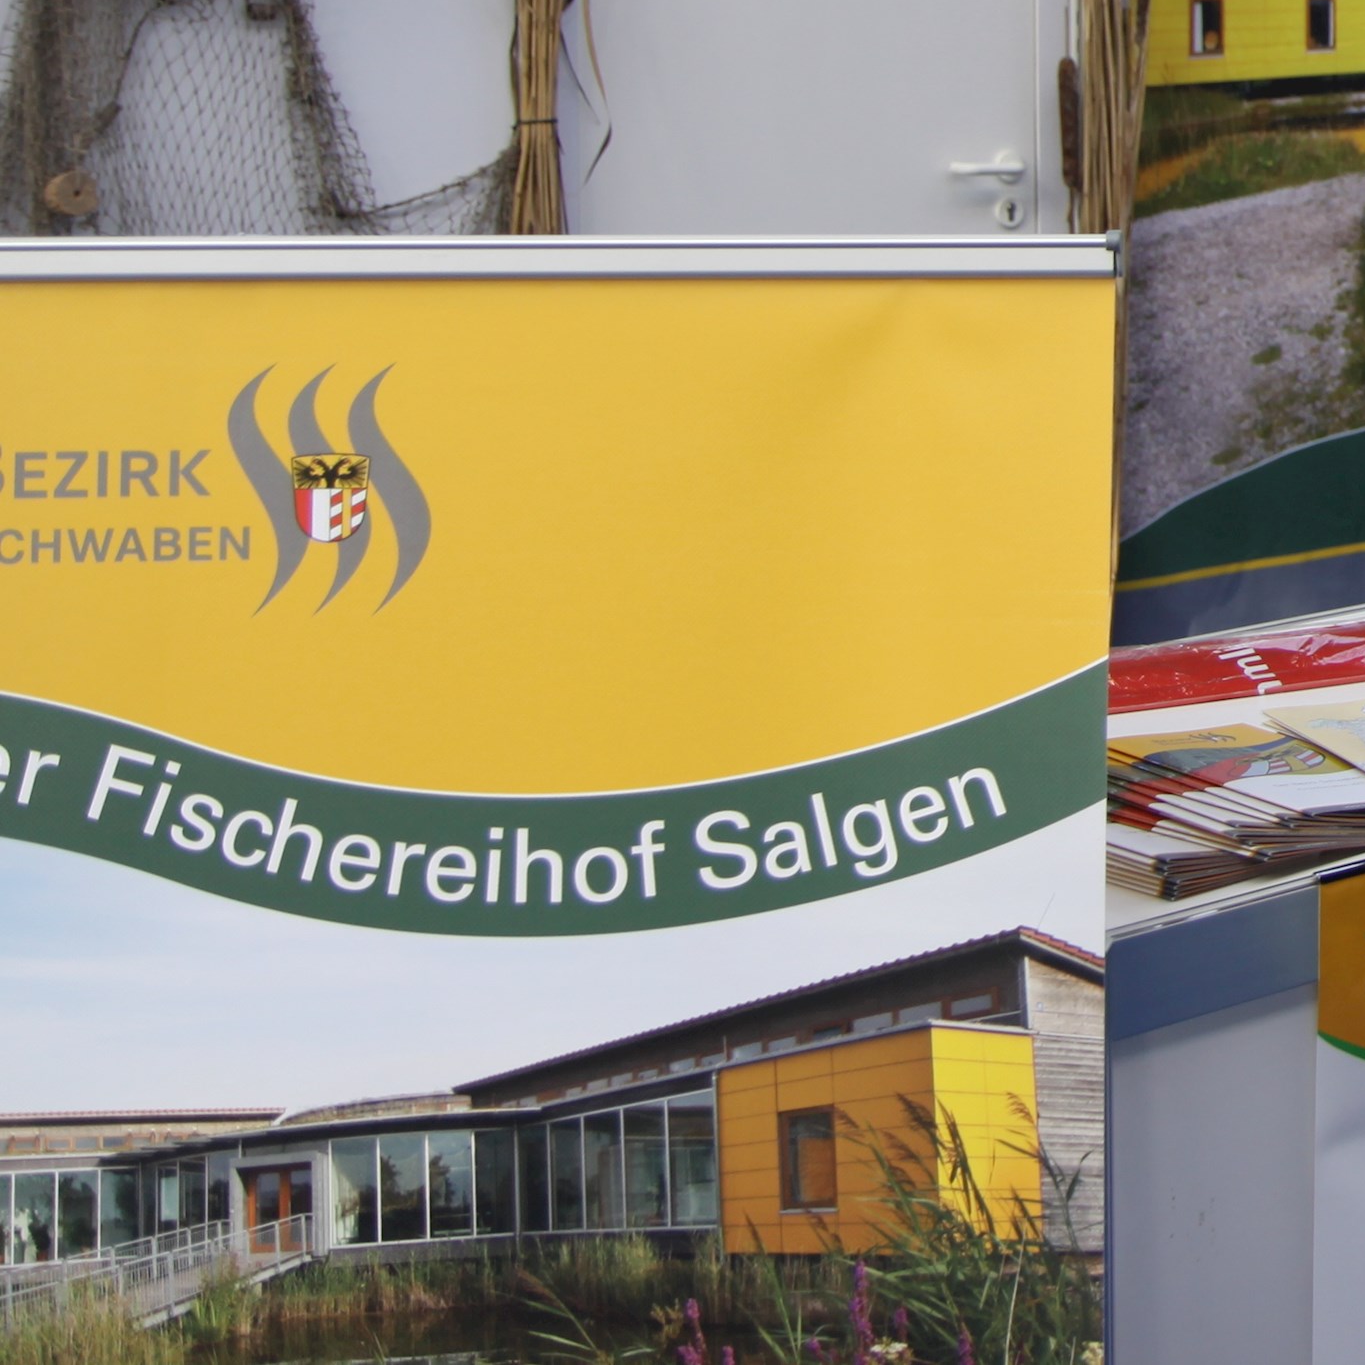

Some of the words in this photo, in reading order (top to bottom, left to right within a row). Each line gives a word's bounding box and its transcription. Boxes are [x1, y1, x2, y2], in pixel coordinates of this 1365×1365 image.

[0, 444, 211, 500] EZIRK
[0, 525, 251, 565] CHWABEN
[87, 743, 668, 906] Fischereihof
[694, 765, 1006, 891] Salgen
